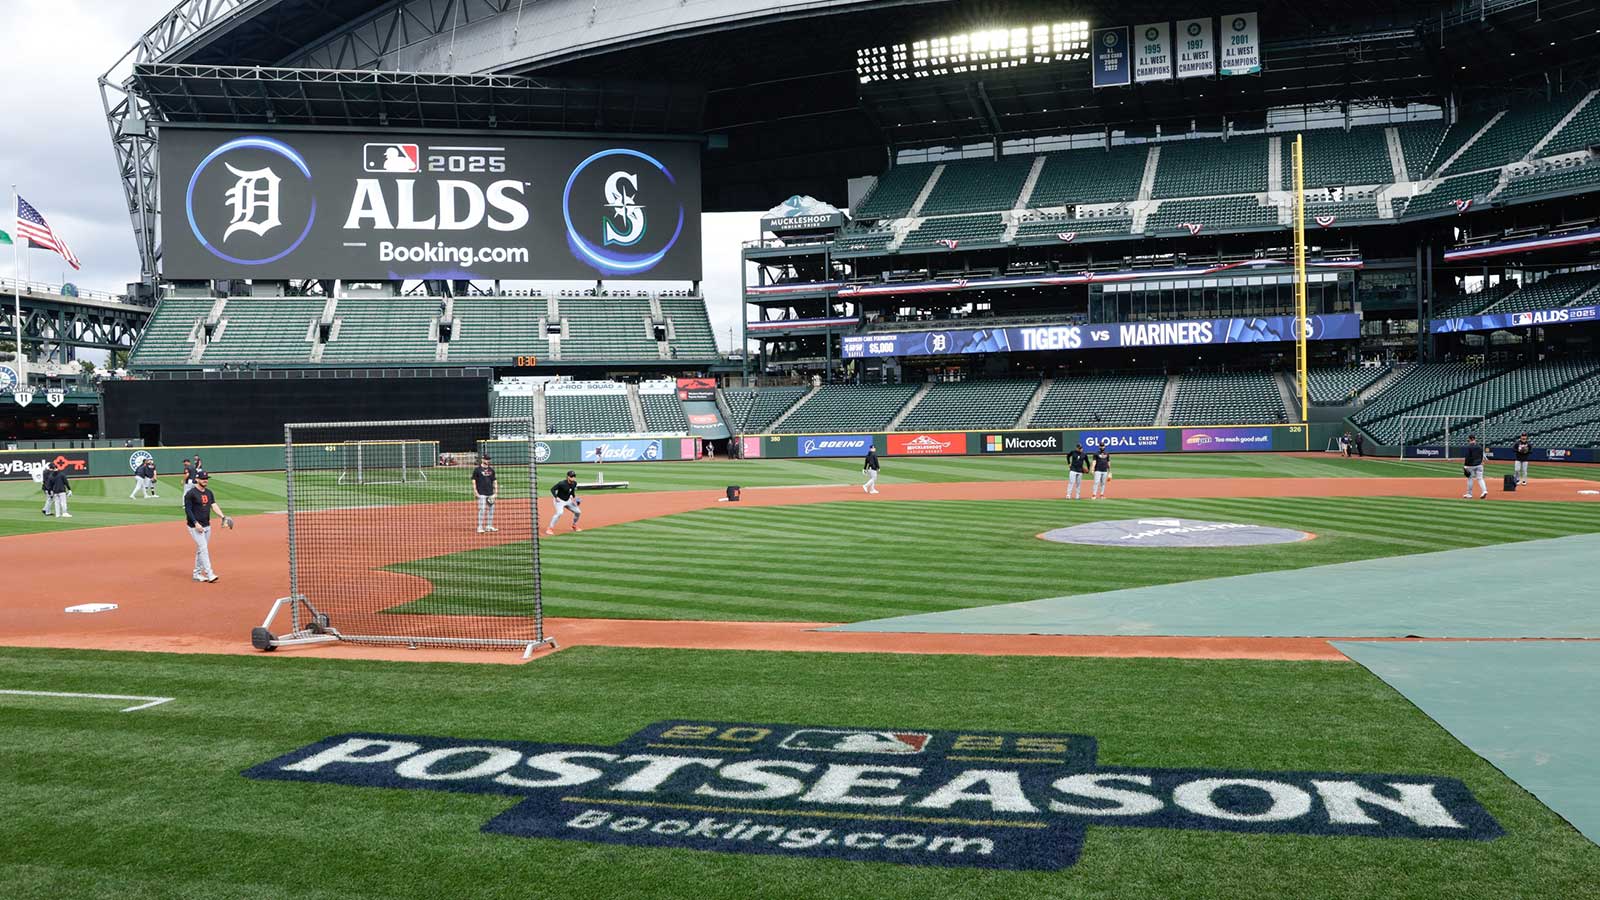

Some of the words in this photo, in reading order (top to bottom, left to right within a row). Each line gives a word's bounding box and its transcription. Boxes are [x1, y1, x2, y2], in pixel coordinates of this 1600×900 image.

[1187, 40, 1204, 49] 1997
[1231, 35, 1249, 45] 2001
[1144, 45, 1161, 54] 1995
[1240, 46, 1254, 56] WEST
[1151, 56, 1166, 65] WEST
[1194, 51, 1209, 60] WEST
[1179, 62, 1213, 73] CHAMPIONS
[1223, 57, 1258, 68] CHAMPIONS
[1137, 66, 1170, 76] CHAMPIONS
[428, 156, 506, 172] 2025
[343, 178, 530, 232] ALDS
[771, 215, 831, 226] MUCKLESHOOT
[379, 241, 529, 267] Booking.com
[1533, 310, 1569, 323] ALDS
[1570, 310, 1595, 318] 2025
[1021, 327, 1081, 350] TIGERS
[1090, 330, 1110, 341] vs
[1120, 322, 1213, 346] MARINERS
[869, 343, 894, 354] $5,000
[518, 356, 537, 367] 0:30
[20, 394, 28, 402] 11
[51, 394, 60, 402] 51
[1005, 437, 1057, 449] Microsoft
[1085, 437, 1136, 446] GLOBAL
[281, 737, 1466, 829] POSTSEASON
[566, 809, 995, 854] Booking.com
